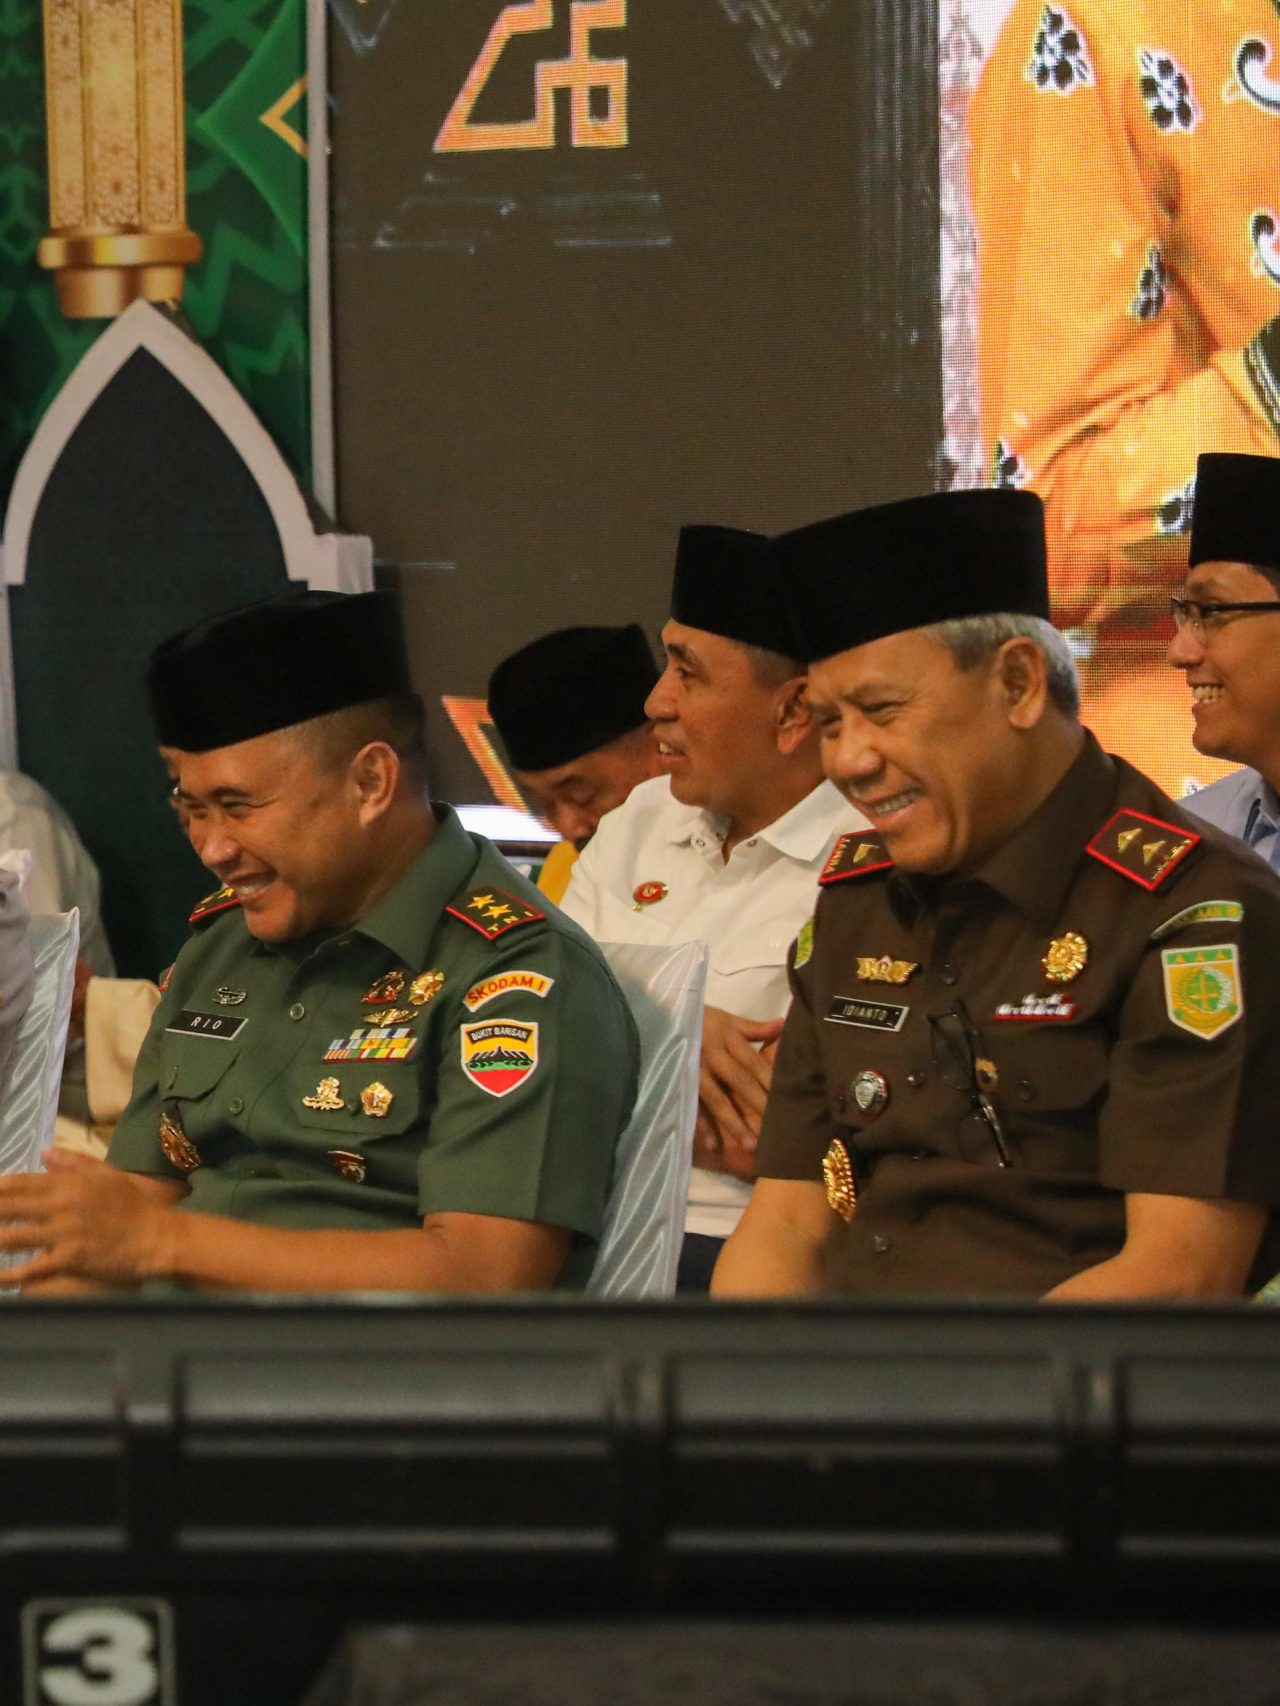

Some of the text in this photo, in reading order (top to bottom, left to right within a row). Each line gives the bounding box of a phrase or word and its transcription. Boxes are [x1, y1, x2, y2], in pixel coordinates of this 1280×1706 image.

[467, 975, 534, 1004] SKODAM
[191, 1016, 223, 1030] RIO
[470, 1028, 493, 1041] BUKIT
[41, 1607, 159, 1706] 3
